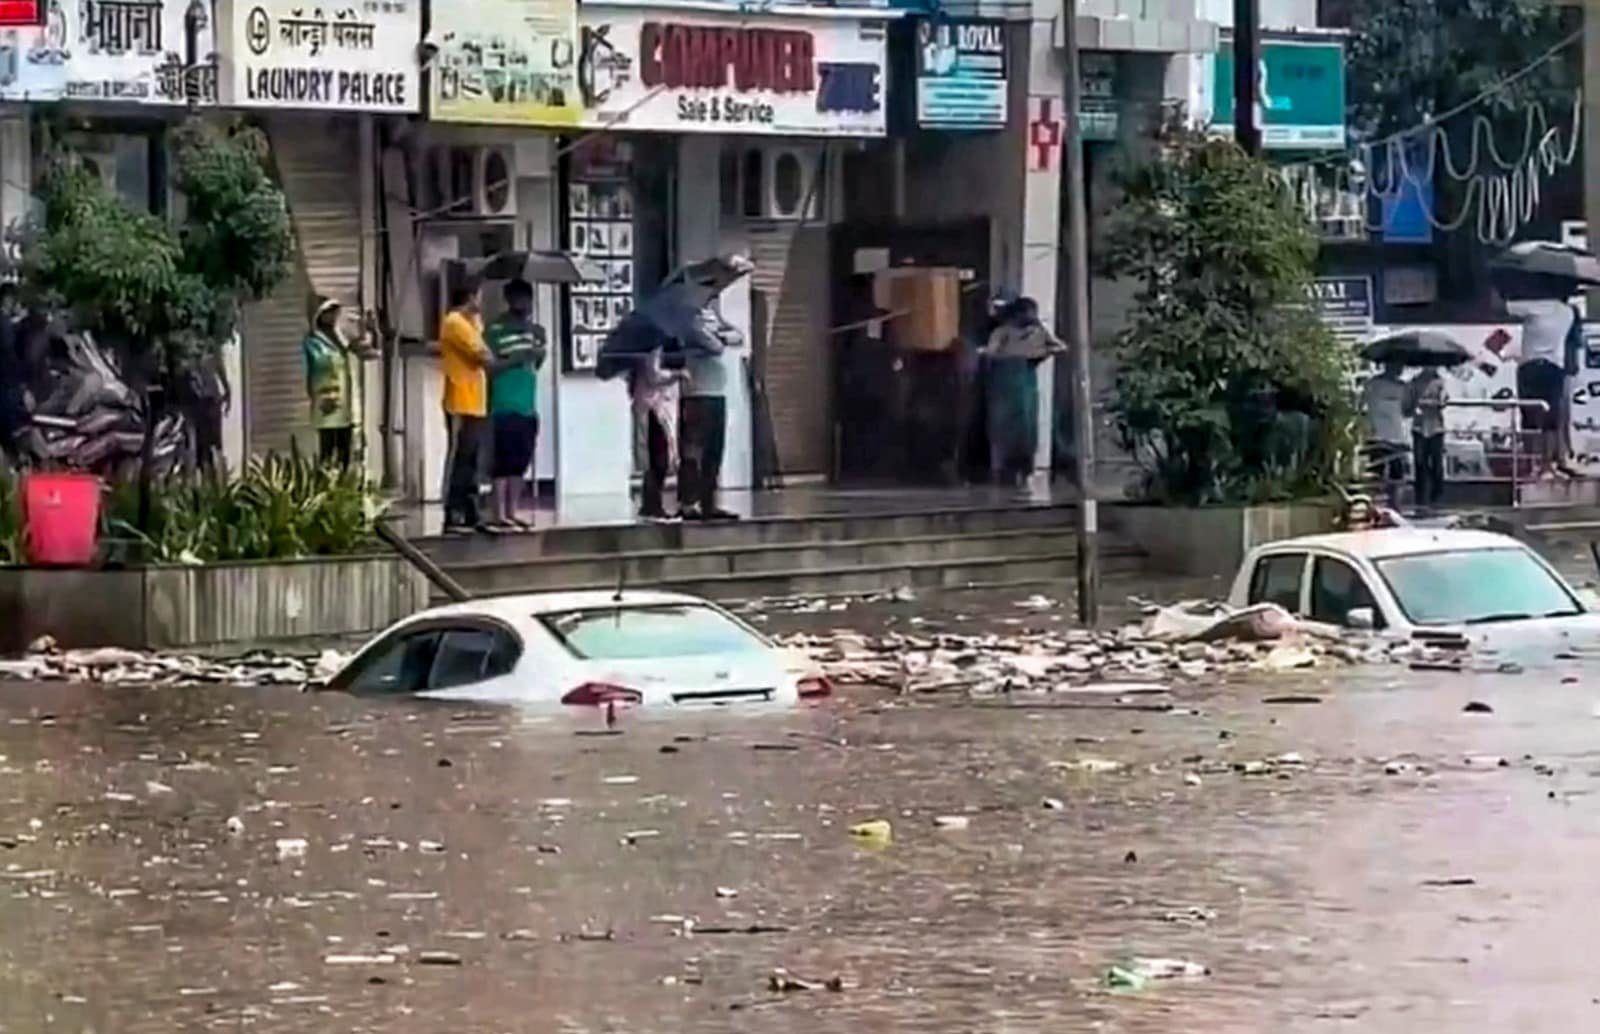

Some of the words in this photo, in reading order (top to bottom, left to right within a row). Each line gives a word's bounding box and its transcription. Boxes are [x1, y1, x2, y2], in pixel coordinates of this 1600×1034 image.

[957, 24, 1003, 52] ROYAL
[247, 67, 333, 101] LAUNDRY
[338, 71, 405, 104] PALACE
[678, 95, 709, 121] Sale
[710, 97, 721, 121] &
[724, 97, 774, 124] Service
